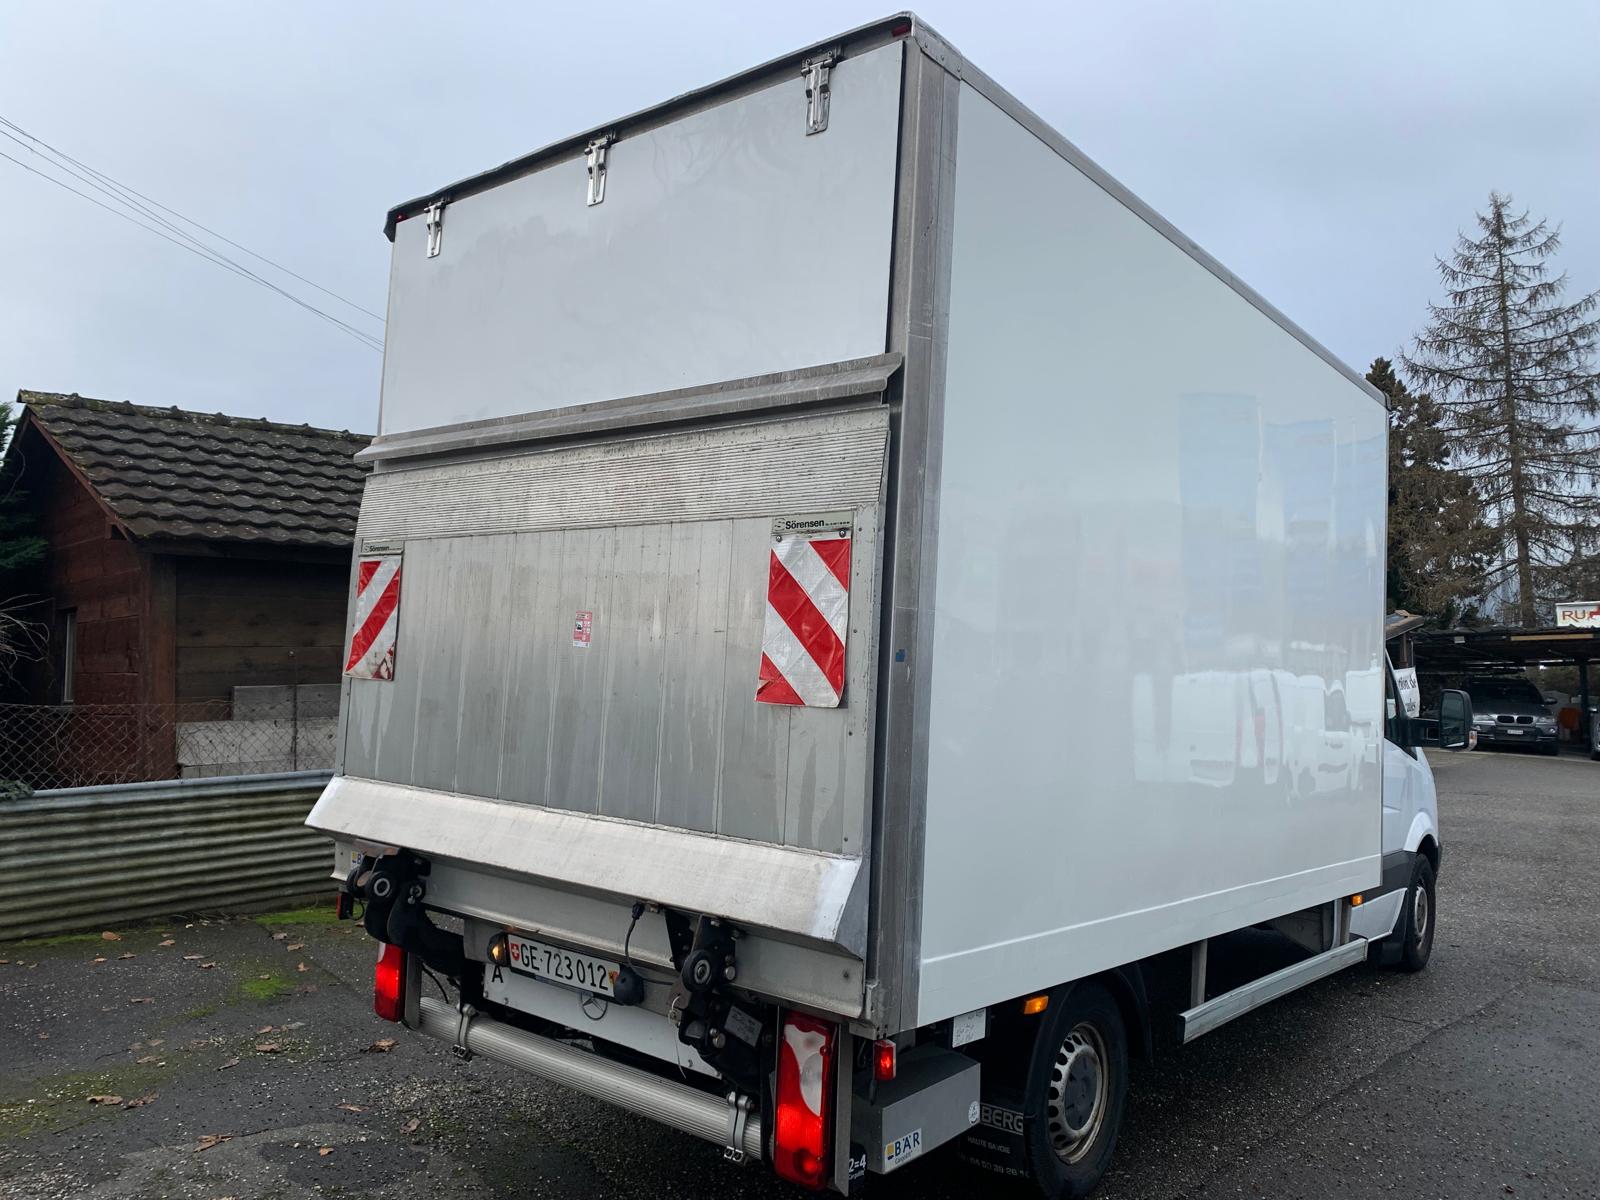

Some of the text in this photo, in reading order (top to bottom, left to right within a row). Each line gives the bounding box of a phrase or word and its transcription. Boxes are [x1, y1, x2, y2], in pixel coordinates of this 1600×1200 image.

[785, 519, 825, 530] Sörensen
[491, 965, 504, 983] A
[894, 1132, 920, 1157] BÄR
